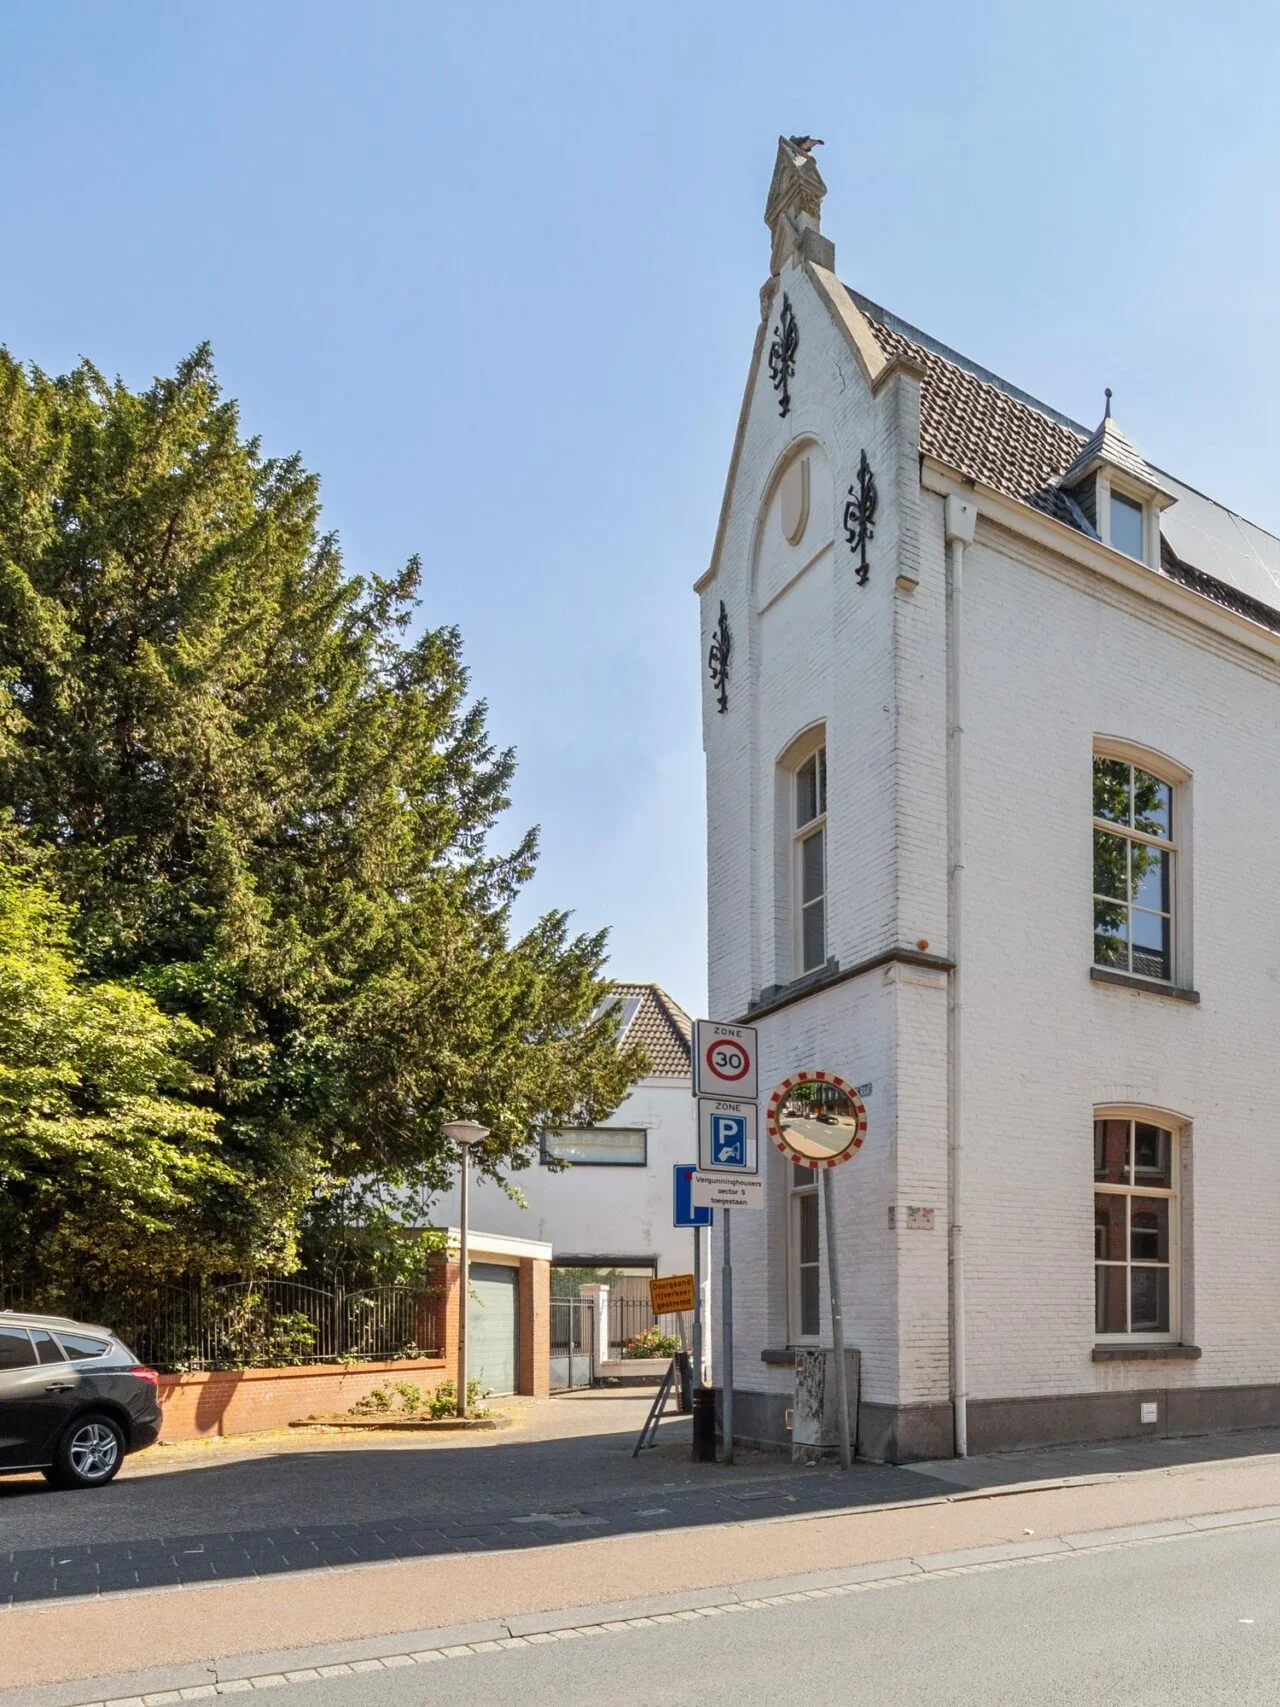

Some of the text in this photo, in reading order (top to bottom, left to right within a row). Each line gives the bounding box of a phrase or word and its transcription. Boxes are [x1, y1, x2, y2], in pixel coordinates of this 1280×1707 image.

[713, 1027, 742, 1037] ZONE
[715, 1052, 742, 1069] 30
[715, 1102, 742, 1111] ZONE
[719, 1119, 738, 1144] P
[717, 1188, 739, 1196] sector
[710, 1197, 748, 1206] toegestaan
[652, 1280, 691, 1290] Doorgaand
[657, 1299, 691, 1309] gestremd
